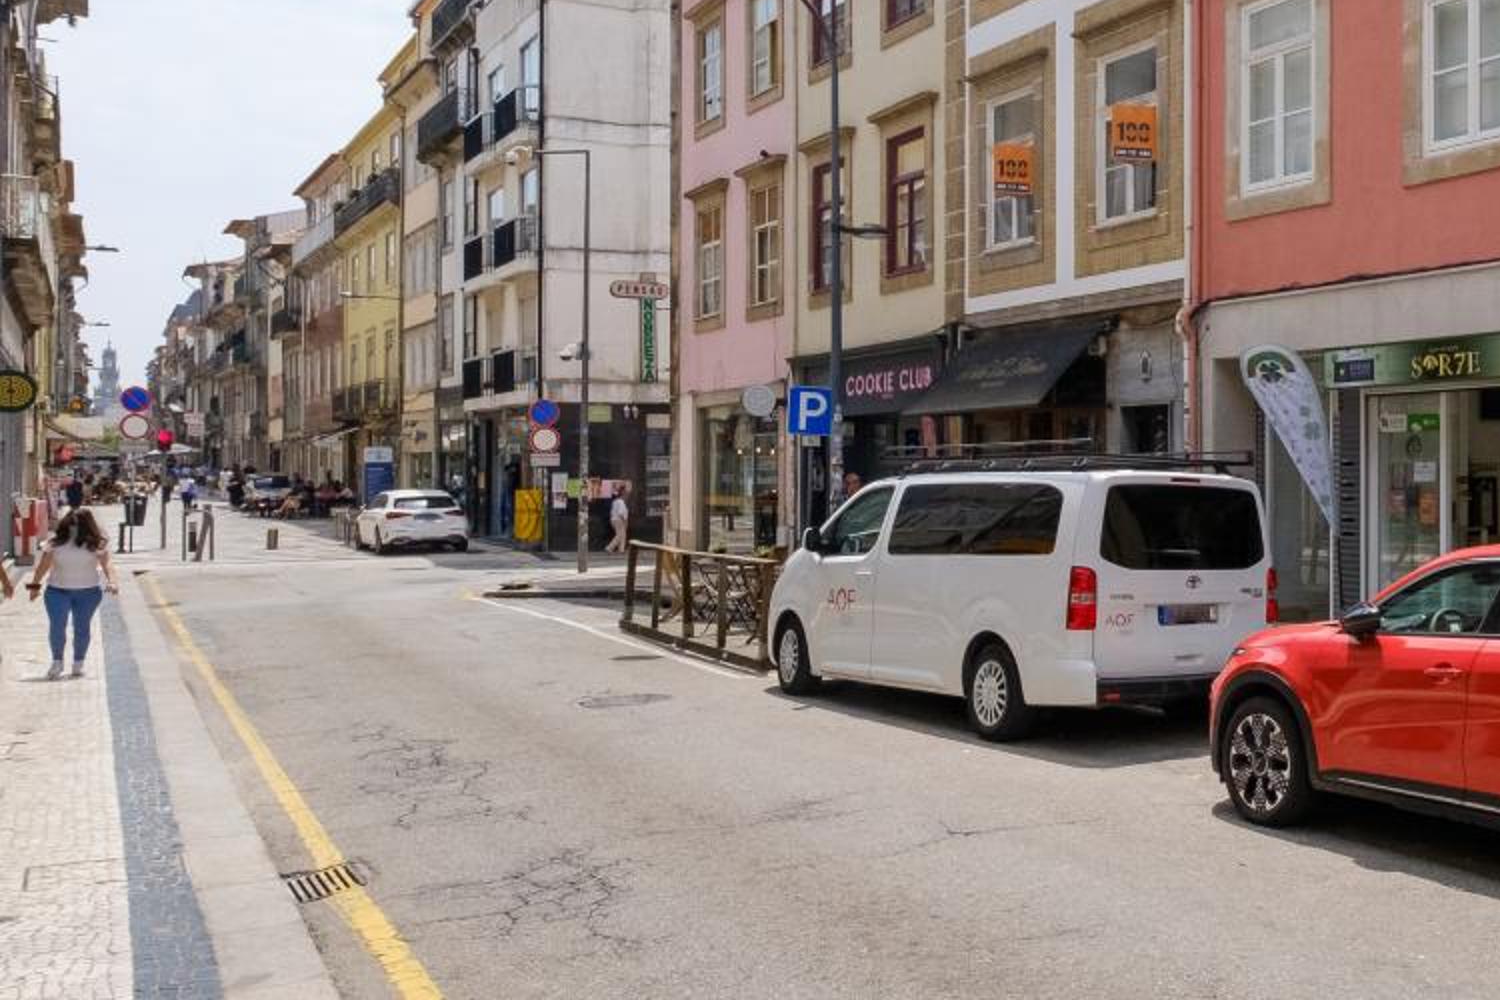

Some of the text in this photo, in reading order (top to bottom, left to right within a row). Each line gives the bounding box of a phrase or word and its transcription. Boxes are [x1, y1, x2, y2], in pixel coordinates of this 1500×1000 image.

[845, 366, 931, 396] COOKIE CLUB
[798, 391, 828, 431] P
